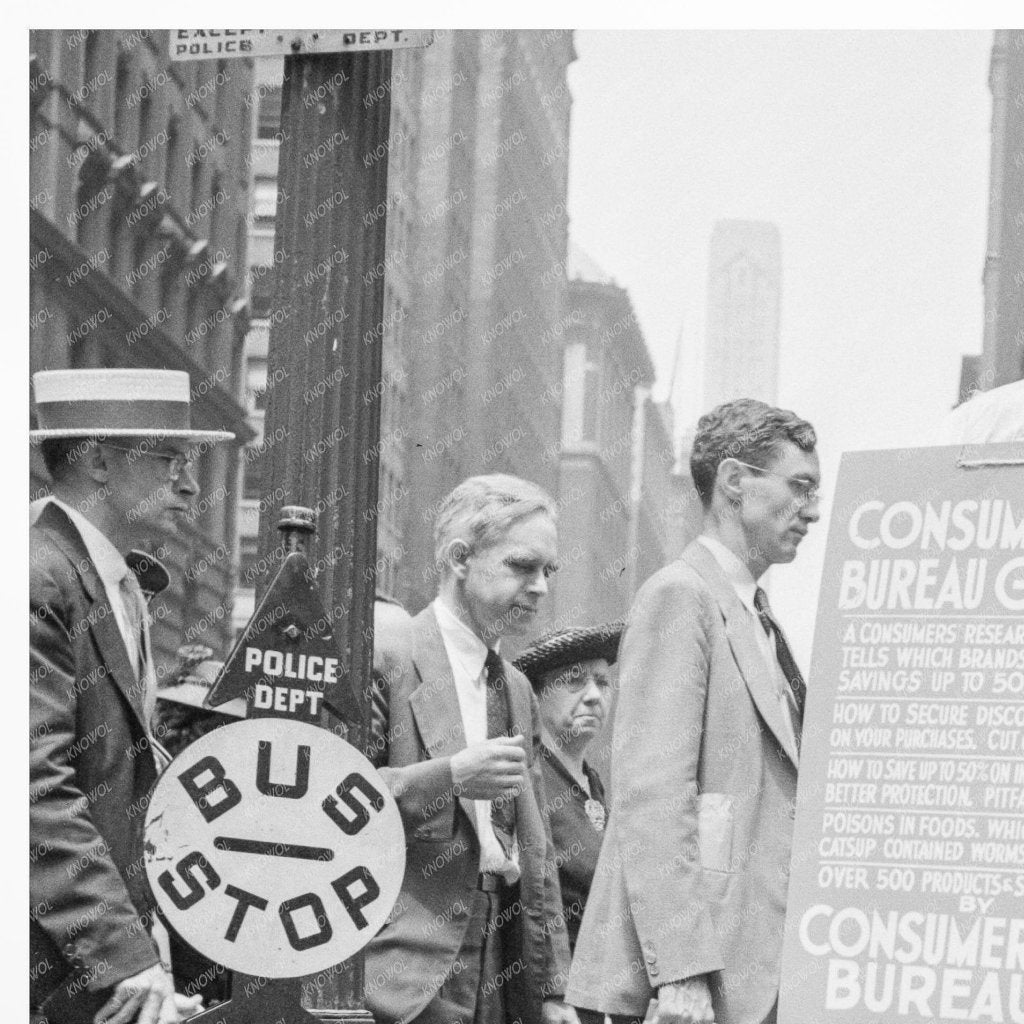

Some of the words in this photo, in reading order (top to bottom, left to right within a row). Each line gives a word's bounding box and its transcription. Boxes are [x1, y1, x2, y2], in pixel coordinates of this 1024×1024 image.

[176, 39, 252, 55] POLICE
[343, 30, 408, 45] DEPT.
[838, 556, 988, 611] BUREAU
[843, 623, 856, 644] A
[245, 647, 339, 685] POLICE
[842, 647, 890, 668] TELLS
[896, 647, 953, 669] WHICH
[837, 670, 923, 692] SAVINGS
[931, 672, 956, 692] UP
[962, 672, 984, 693] TO
[254, 683, 324, 716] DEPT
[832, 702, 876, 724] HOW
[880, 703, 901, 724] TO
[906, 703, 970, 726] SECURE
[830, 728, 851, 748] ON
[854, 728, 892, 748] YOUR
[895, 729, 978, 750] PURCHASES.
[988, 730, 1020, 751] CUT
[827, 758, 864, 780] HOW
[865, 759, 883, 780] TO
[884, 759, 918, 780] SAVE
[919, 760, 938, 781] UP
[939, 761, 956, 781] TO
[956, 761, 989, 782] 50%
[990, 762, 1011, 784] ON
[178, 740, 386, 836] BUS
[825, 783, 878, 804] BETTER
[881, 783, 973, 807] PROTECTION.
[822, 812, 895, 834] POISONS
[900, 815, 916, 836] IN
[919, 816, 980, 838] FOODS.
[819, 837, 877, 859] CATSUP
[883, 838, 965, 861] CONTAINED
[818, 865, 870, 890] OVER
[876, 868, 915, 891] 500
[158, 850, 382, 952] STOP
[959, 895, 995, 914] BY
